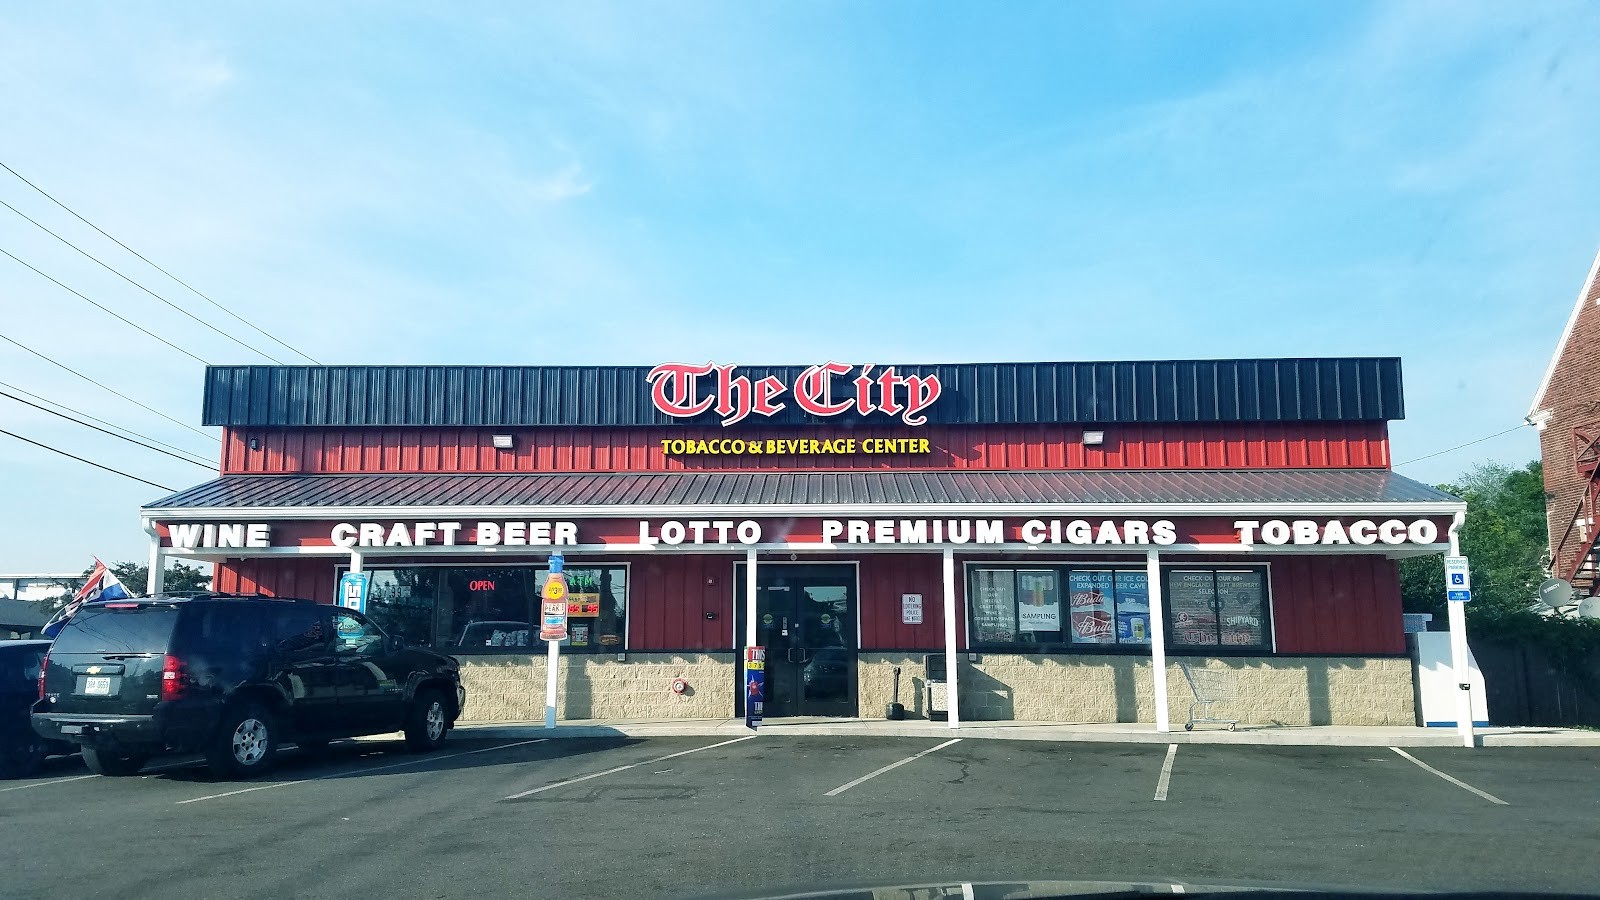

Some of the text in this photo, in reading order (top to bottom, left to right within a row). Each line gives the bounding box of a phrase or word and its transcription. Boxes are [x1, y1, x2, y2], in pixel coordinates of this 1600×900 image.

[645, 360, 942, 427] The City
[661, 438, 931, 455] TOBACCO & BEVERAGE CENTER
[168, 523, 271, 548] WINE
[330, 521, 579, 548] CRAFT BEER
[638, 520, 763, 545] LOTTO
[822, 519, 1178, 545] PREMIUM CIGARS
[1233, 519, 1438, 546] TOBACCO
[469, 580, 495, 592] OPEN
[569, 576, 593, 586] ATM
[1129, 582, 1146, 590] CAVE
[1226, 615, 1259, 627] SHIPYARD
